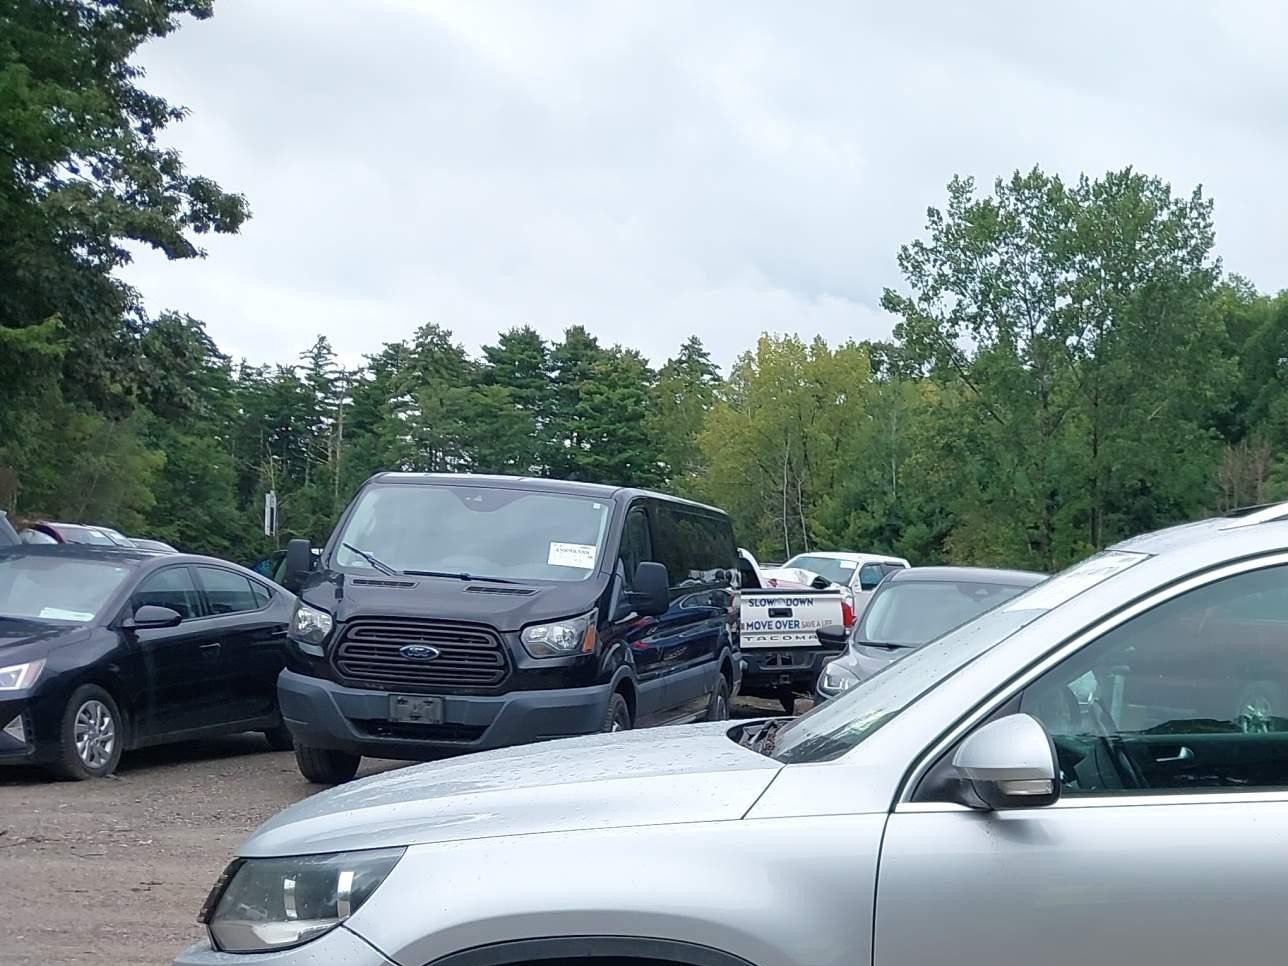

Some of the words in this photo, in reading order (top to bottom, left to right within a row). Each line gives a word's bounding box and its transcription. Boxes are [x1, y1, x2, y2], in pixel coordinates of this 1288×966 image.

[748, 598, 775, 607] SLOW
[786, 598, 814, 607] DOWN
[746, 620, 773, 630] MOVE
[775, 619, 800, 629] OVER
[743, 634, 818, 642] TACOMA
